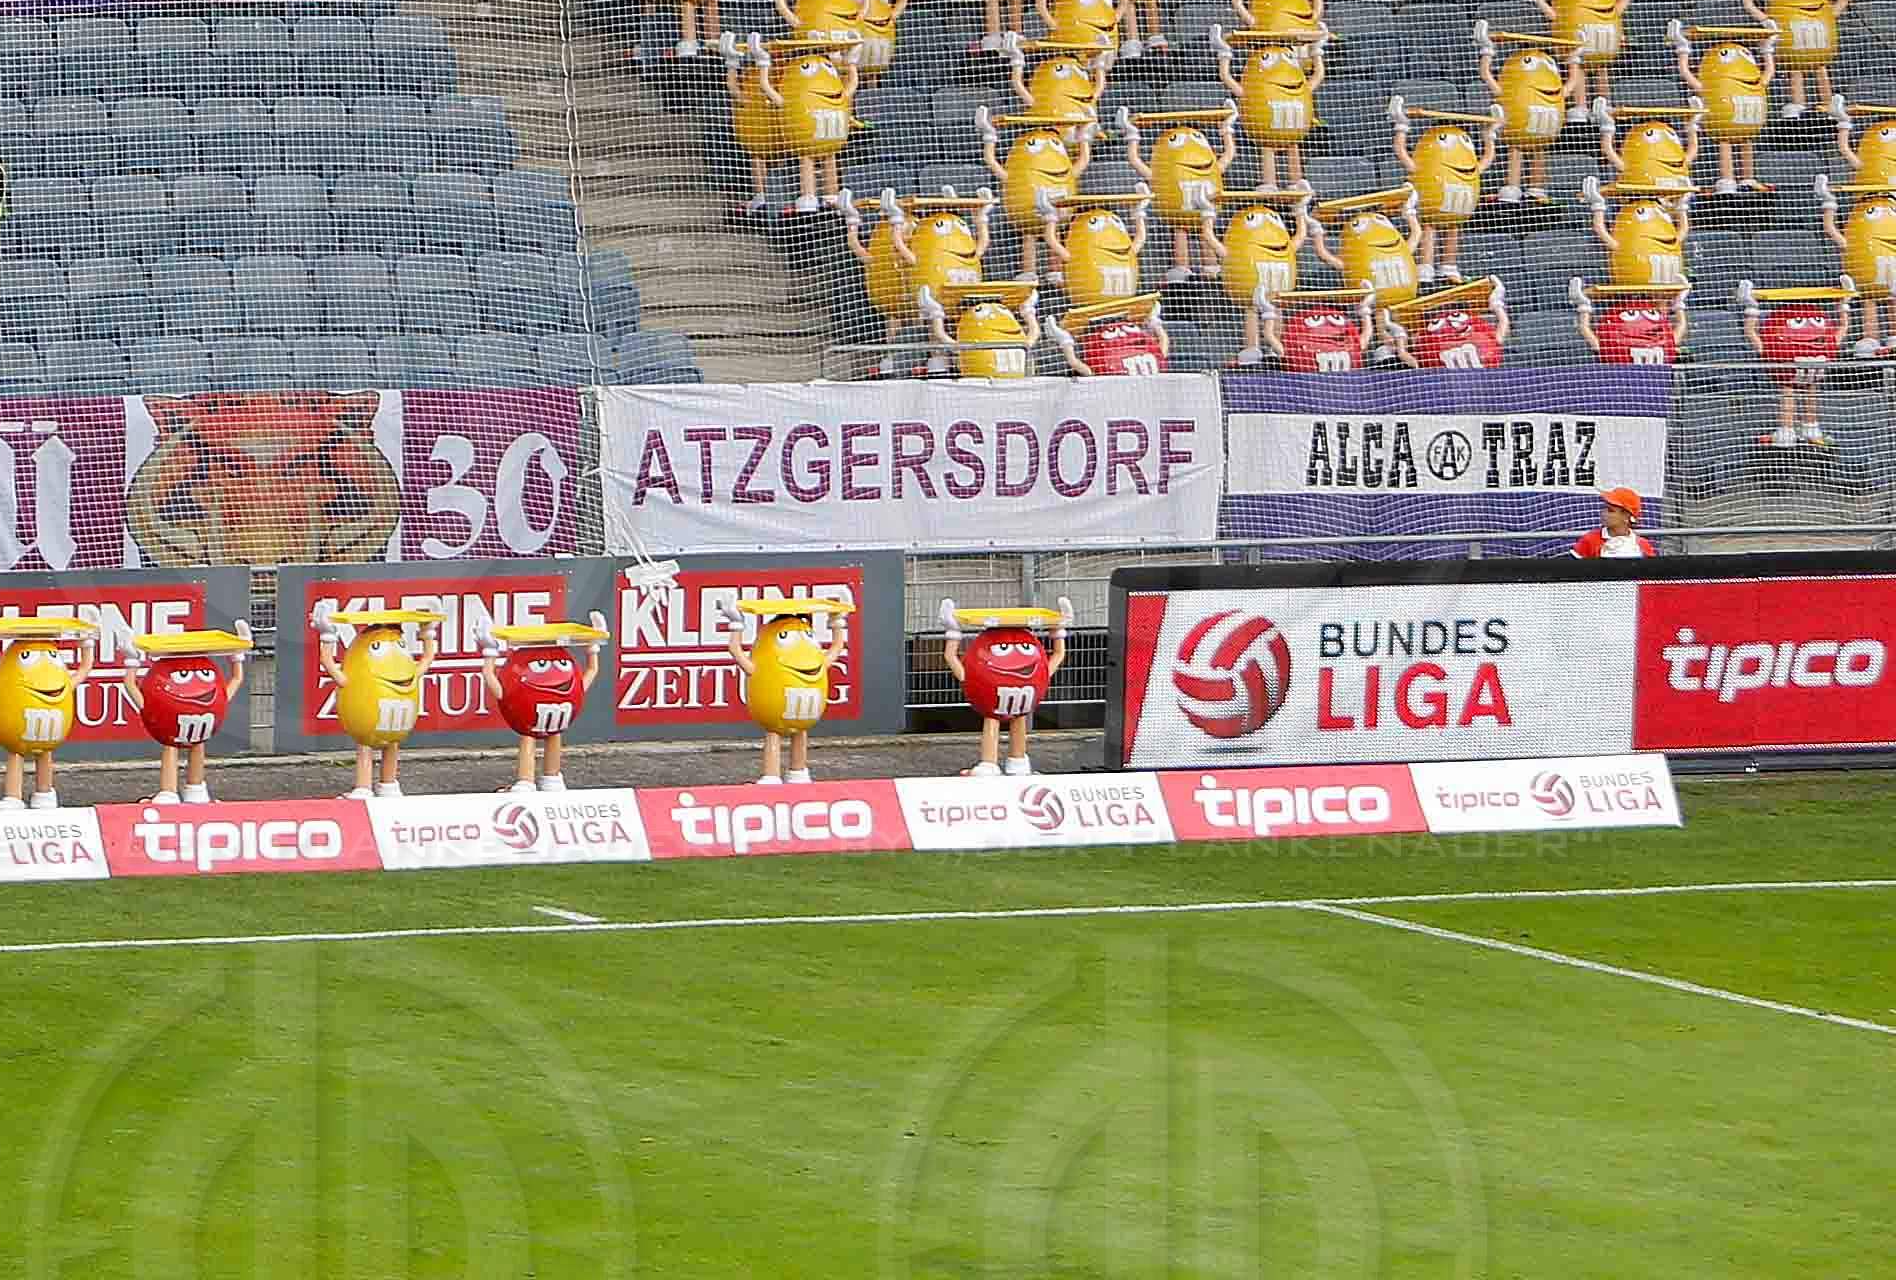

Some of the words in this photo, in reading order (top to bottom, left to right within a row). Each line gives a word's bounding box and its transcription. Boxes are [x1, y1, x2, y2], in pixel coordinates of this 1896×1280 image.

[632, 416, 1195, 509] ATZGERSDORF
[1308, 421, 1418, 488] ALCA
[1480, 420, 1596, 488] TRAZ
[419, 431, 570, 558] 30
[1318, 618, 1511, 658] BUNDES
[1662, 627, 1886, 703] tipico
[782, 685, 821, 720] m
[995, 685, 1038, 716] m
[1317, 662, 1512, 732] LIGA
[21, 707, 63, 741] m
[174, 710, 215, 744] m
[374, 697, 416, 731] m
[533, 701, 574, 734] m
[1070, 786, 1143, 802] BUNDES
[1579, 771, 1655, 789] BUNDES
[545, 804, 621, 820] BUNDES
[920, 800, 1007, 826] tipico
[1194, 775, 1389, 834] tipico
[1435, 785, 1520, 810] tipico
[1585, 790, 1663, 813] LIGA
[671, 791, 873, 855] tipico
[1076, 803, 1154, 827] LIGA
[4, 824, 82, 840] BUNDES
[134, 806, 341, 871] tipico
[390, 821, 480, 844] tipico
[550, 821, 630, 845] LIGA
[10, 841, 92, 865] LIGA
